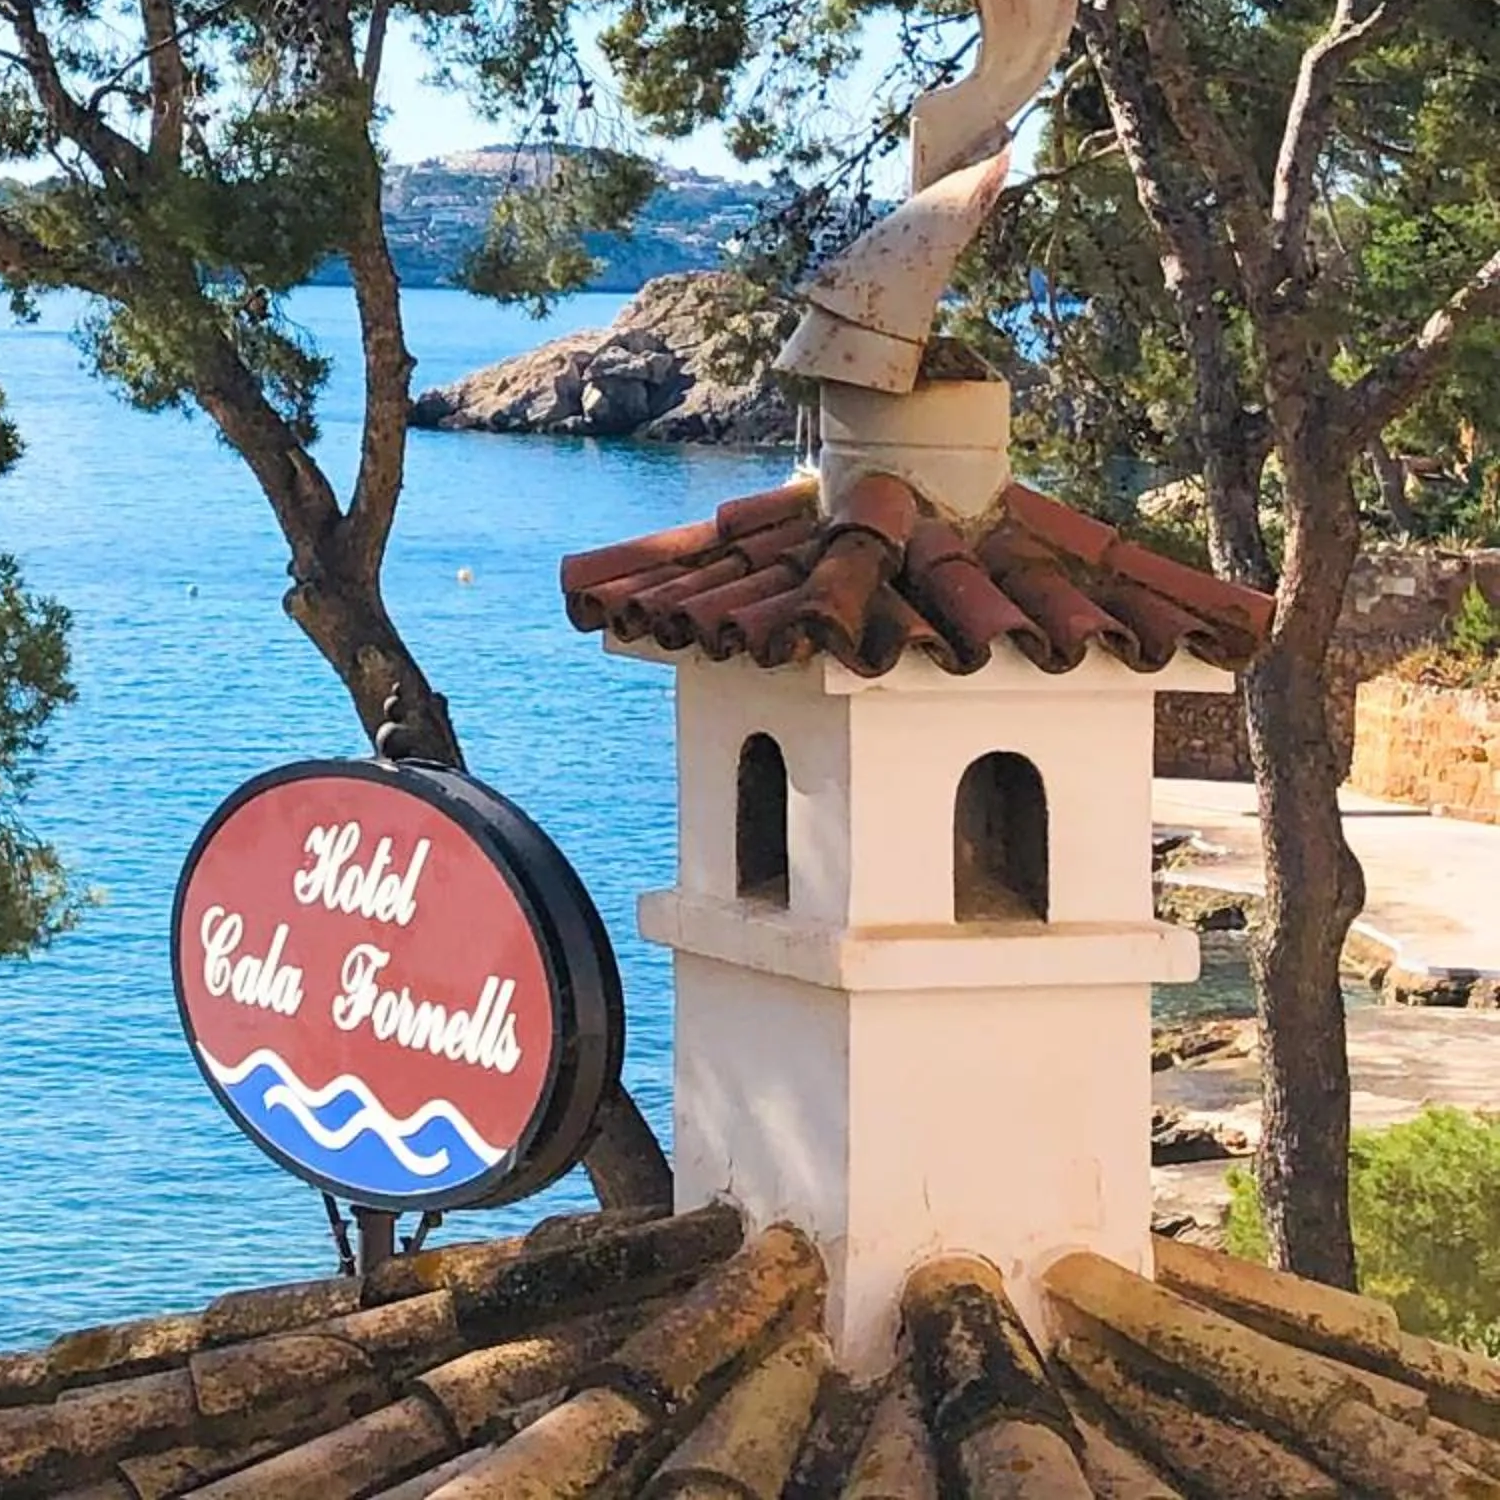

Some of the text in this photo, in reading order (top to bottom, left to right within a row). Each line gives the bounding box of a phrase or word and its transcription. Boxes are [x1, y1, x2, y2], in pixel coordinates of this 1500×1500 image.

[294, 821, 431, 927] Hotel
[200, 906, 521, 1074] Cala Fornells
